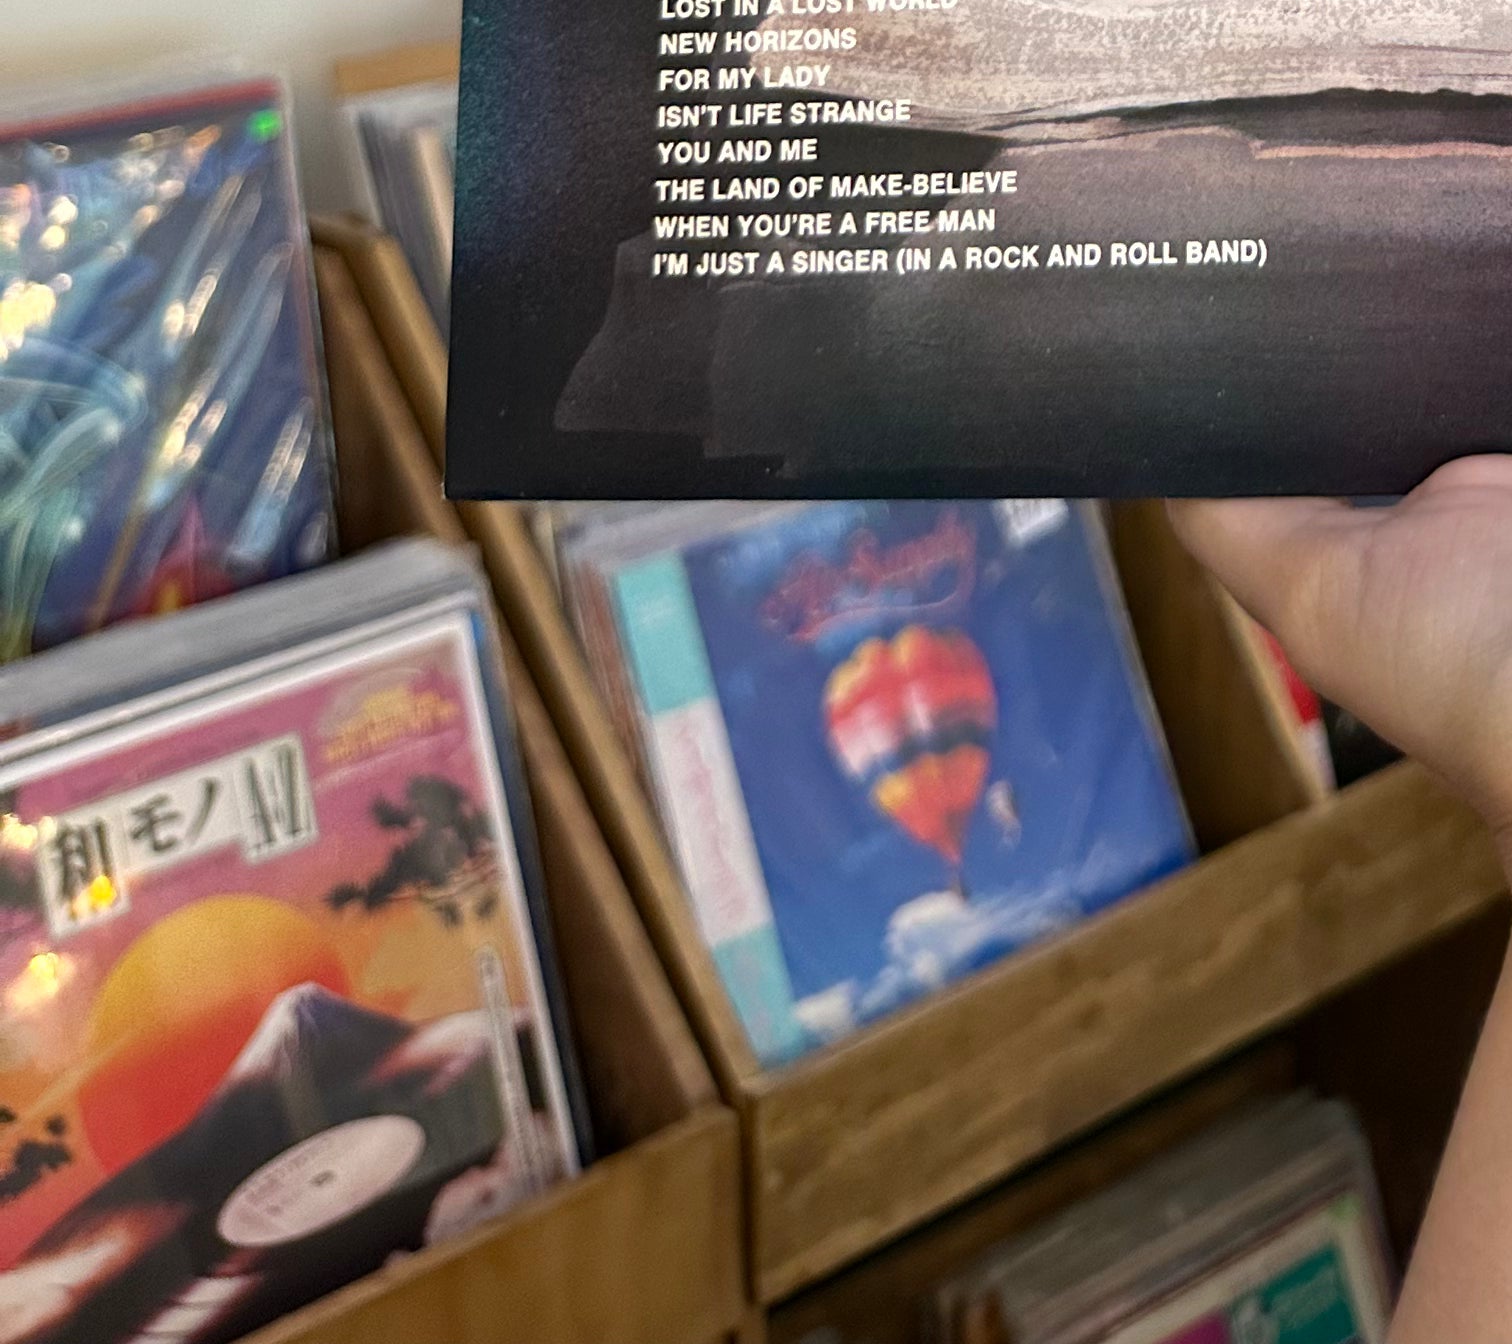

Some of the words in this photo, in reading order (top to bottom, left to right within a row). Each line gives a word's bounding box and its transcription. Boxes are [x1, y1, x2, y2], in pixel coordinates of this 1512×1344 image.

[660, 31, 717, 55] NEW
[725, 27, 857, 53] HORIZONS
[659, 68, 709, 91] FOR
[718, 67, 756, 90] MY
[764, 65, 831, 88] LADY
[658, 104, 722, 127] ISN'T
[730, 102, 782, 126] LIFE
[790, 98, 911, 124] STRANGE
[658, 141, 710, 164] YOU
[718, 139, 772, 162] AND
[780, 137, 818, 161] ME
[655, 178, 705, 201] THE
[712, 177, 780, 200] LAND
[789, 176, 824, 199] OF
[830, 170, 1018, 198] MAKE-BELIEVE
[655, 214, 729, 238] WHEN
[737, 212, 832, 237] YOU'RE
[839, 212, 857, 234] A
[865, 210, 930, 234] FREE
[938, 208, 996, 233] MAN
[653, 252, 688, 275] I'M
[696, 251, 759, 275] JUST
[766, 251, 785, 273] A
[792, 248, 888, 273] SINGER
[896, 247, 931, 275] (IN
[939, 247, 957, 270] A
[965, 244, 1039, 270] ROCK
[1047, 243, 1102, 268] AND
[1110, 241, 1177, 266] ROLL
[1186, 238, 1268, 268] BAND)
